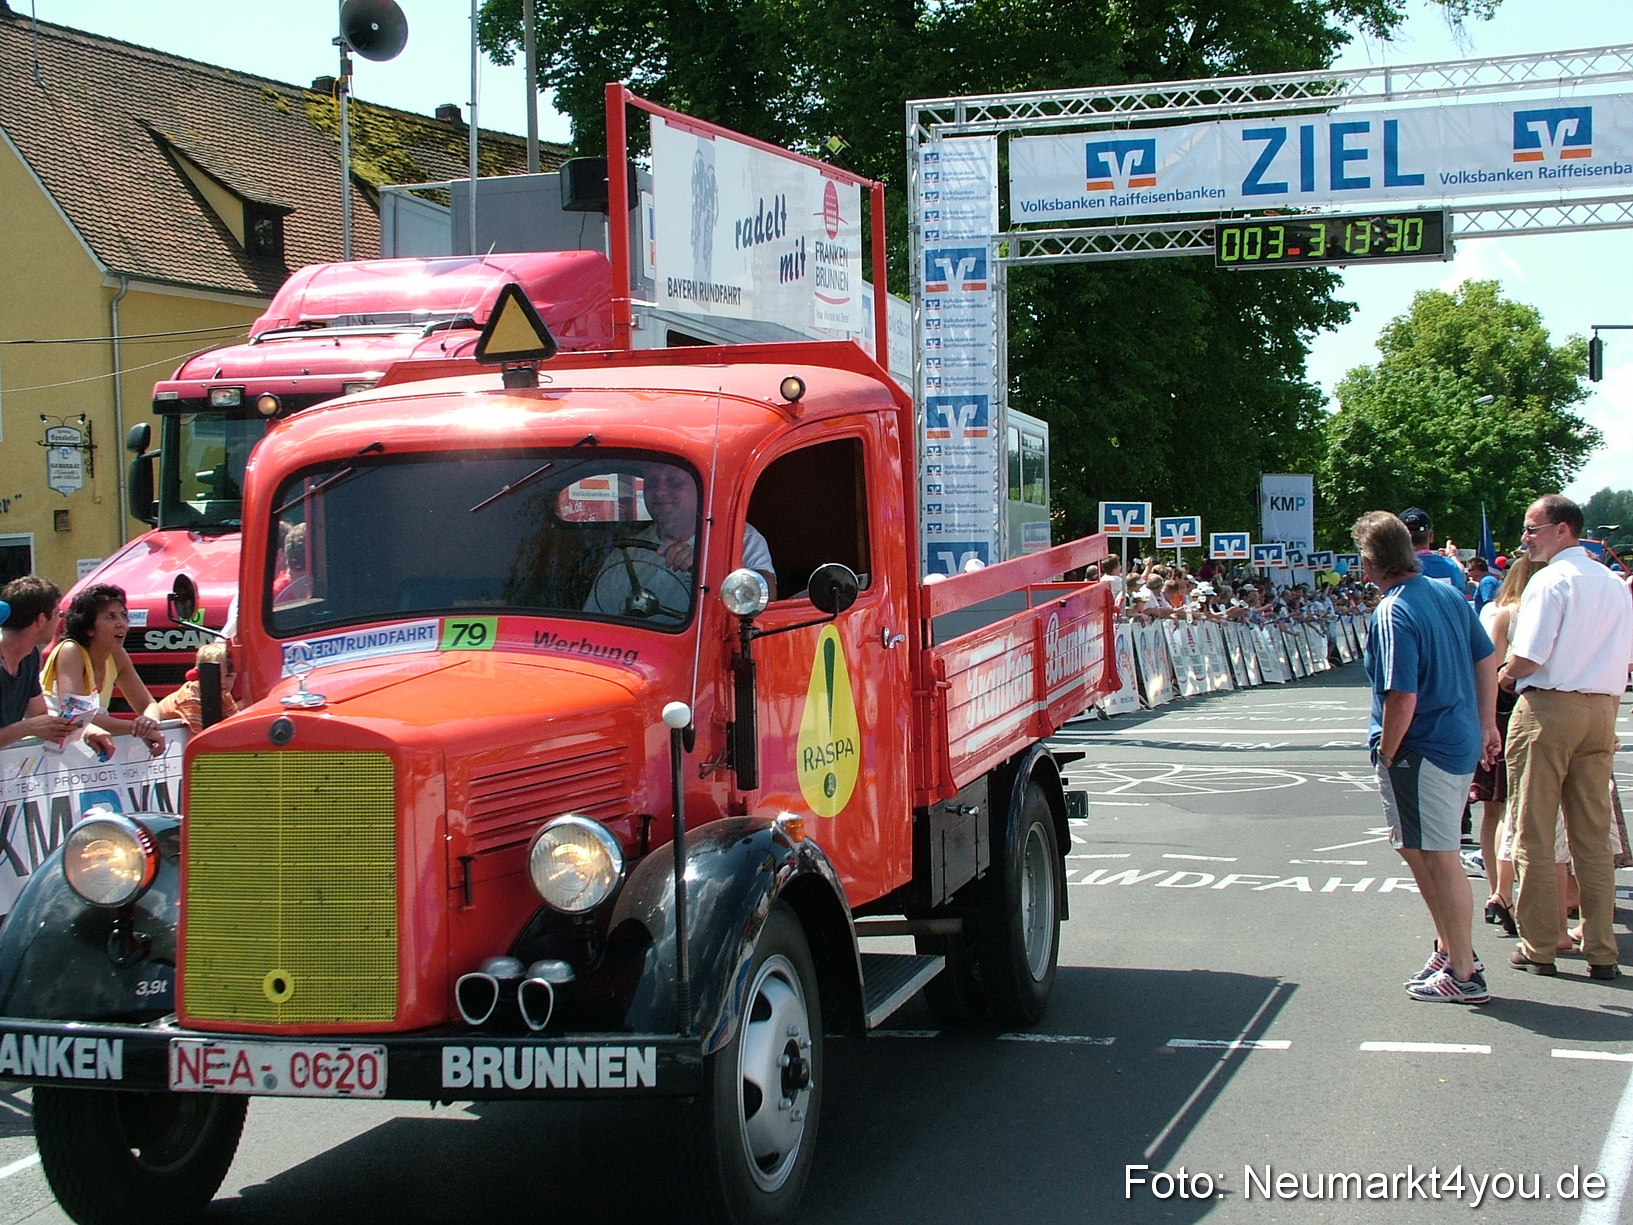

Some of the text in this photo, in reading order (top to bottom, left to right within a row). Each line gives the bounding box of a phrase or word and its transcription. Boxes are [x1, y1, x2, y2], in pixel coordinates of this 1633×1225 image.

[1241, 119, 1426, 197] ZIEL
[1439, 167, 1534, 186] Volksbanken
[1020, 186, 1227, 213] Volksbanken Raiffeisenbanken
[735, 194, 787, 250] radelt
[815, 240, 849, 268] FRANKEN
[1221, 226, 1284, 262] 003
[780, 235, 806, 285] mit
[667, 277, 742, 306] BAYERN RUNDFAHRT
[815, 266, 849, 292] BRUNNEN
[1270, 496, 1306, 511] KMP
[346, 625, 436, 652] RUNDFAHRT
[450, 622, 487, 647] 79
[534, 630, 639, 667] Werbung
[149, 762, 171, 775] TECH
[803, 737, 854, 772] RASPA
[15, 769, 118, 794] TECH PRODUCTS
[135, 979, 168, 996] 3,9t
[0, 1033, 124, 1080] ANKEN
[441, 1045, 657, 1090] BRUNNEN
[290, 1051, 379, 1091] 0620
